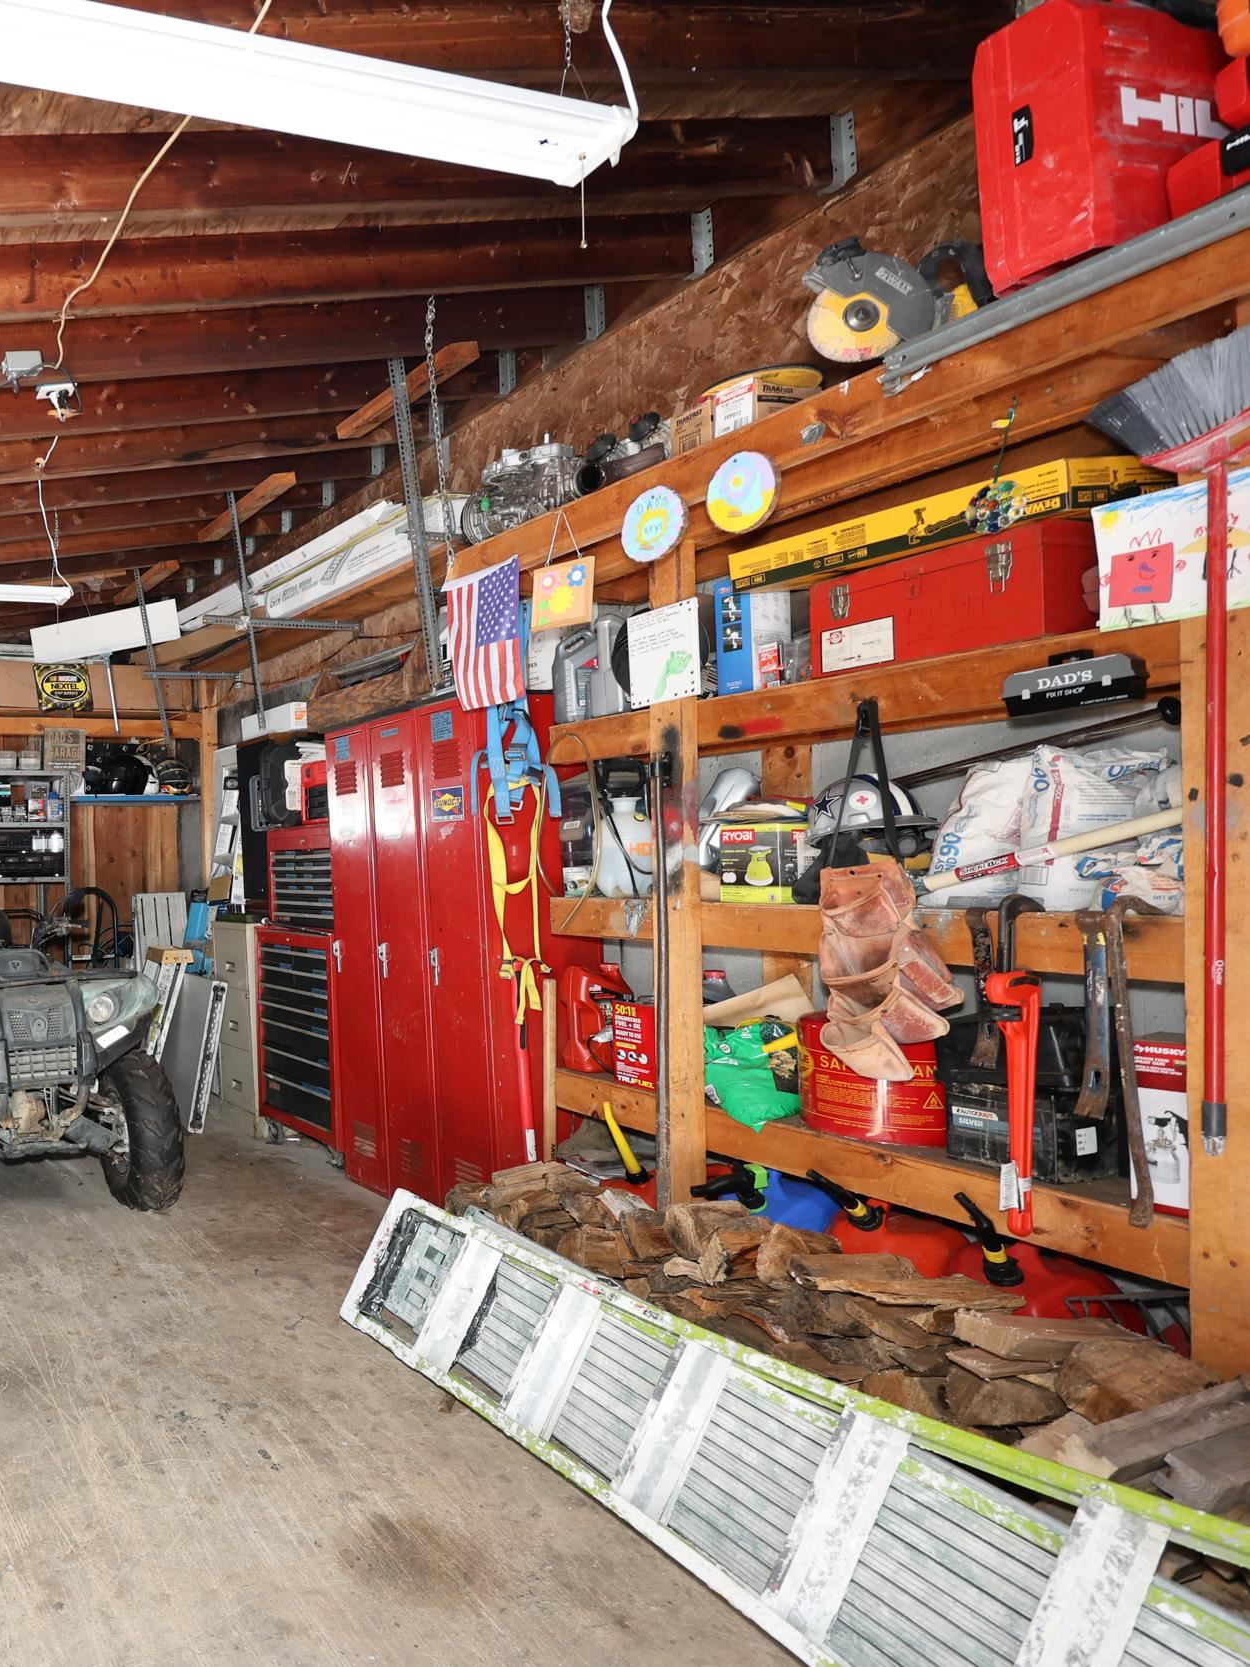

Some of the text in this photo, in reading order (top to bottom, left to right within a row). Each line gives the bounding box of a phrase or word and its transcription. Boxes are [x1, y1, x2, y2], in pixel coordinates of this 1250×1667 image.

[1120, 86, 1231, 140] HIL
[1226, 134, 1250, 151] HIL
[1026, 498, 1061, 515] DEWA
[1037, 669, 1093, 690] DAD'S
[1064, 687, 1086, 696] SHOP
[434, 797, 462, 809] SUNOCO
[722, 831, 753, 842] RYOBI
[940, 832, 963, 857] 90
[615, 1004, 631, 1017] 50:1
[615, 1015, 641, 1023] ENGINEERED
[616, 1029, 628, 1037] READY
[1145, 1046, 1186, 1057] HUSKY
[914, 1064, 936, 1079] AN
[617, 1074, 655, 1089] TRUFUEL
[960, 1108, 994, 1119] AUTOCRAFT
[958, 1117, 984, 1127] SILVER
